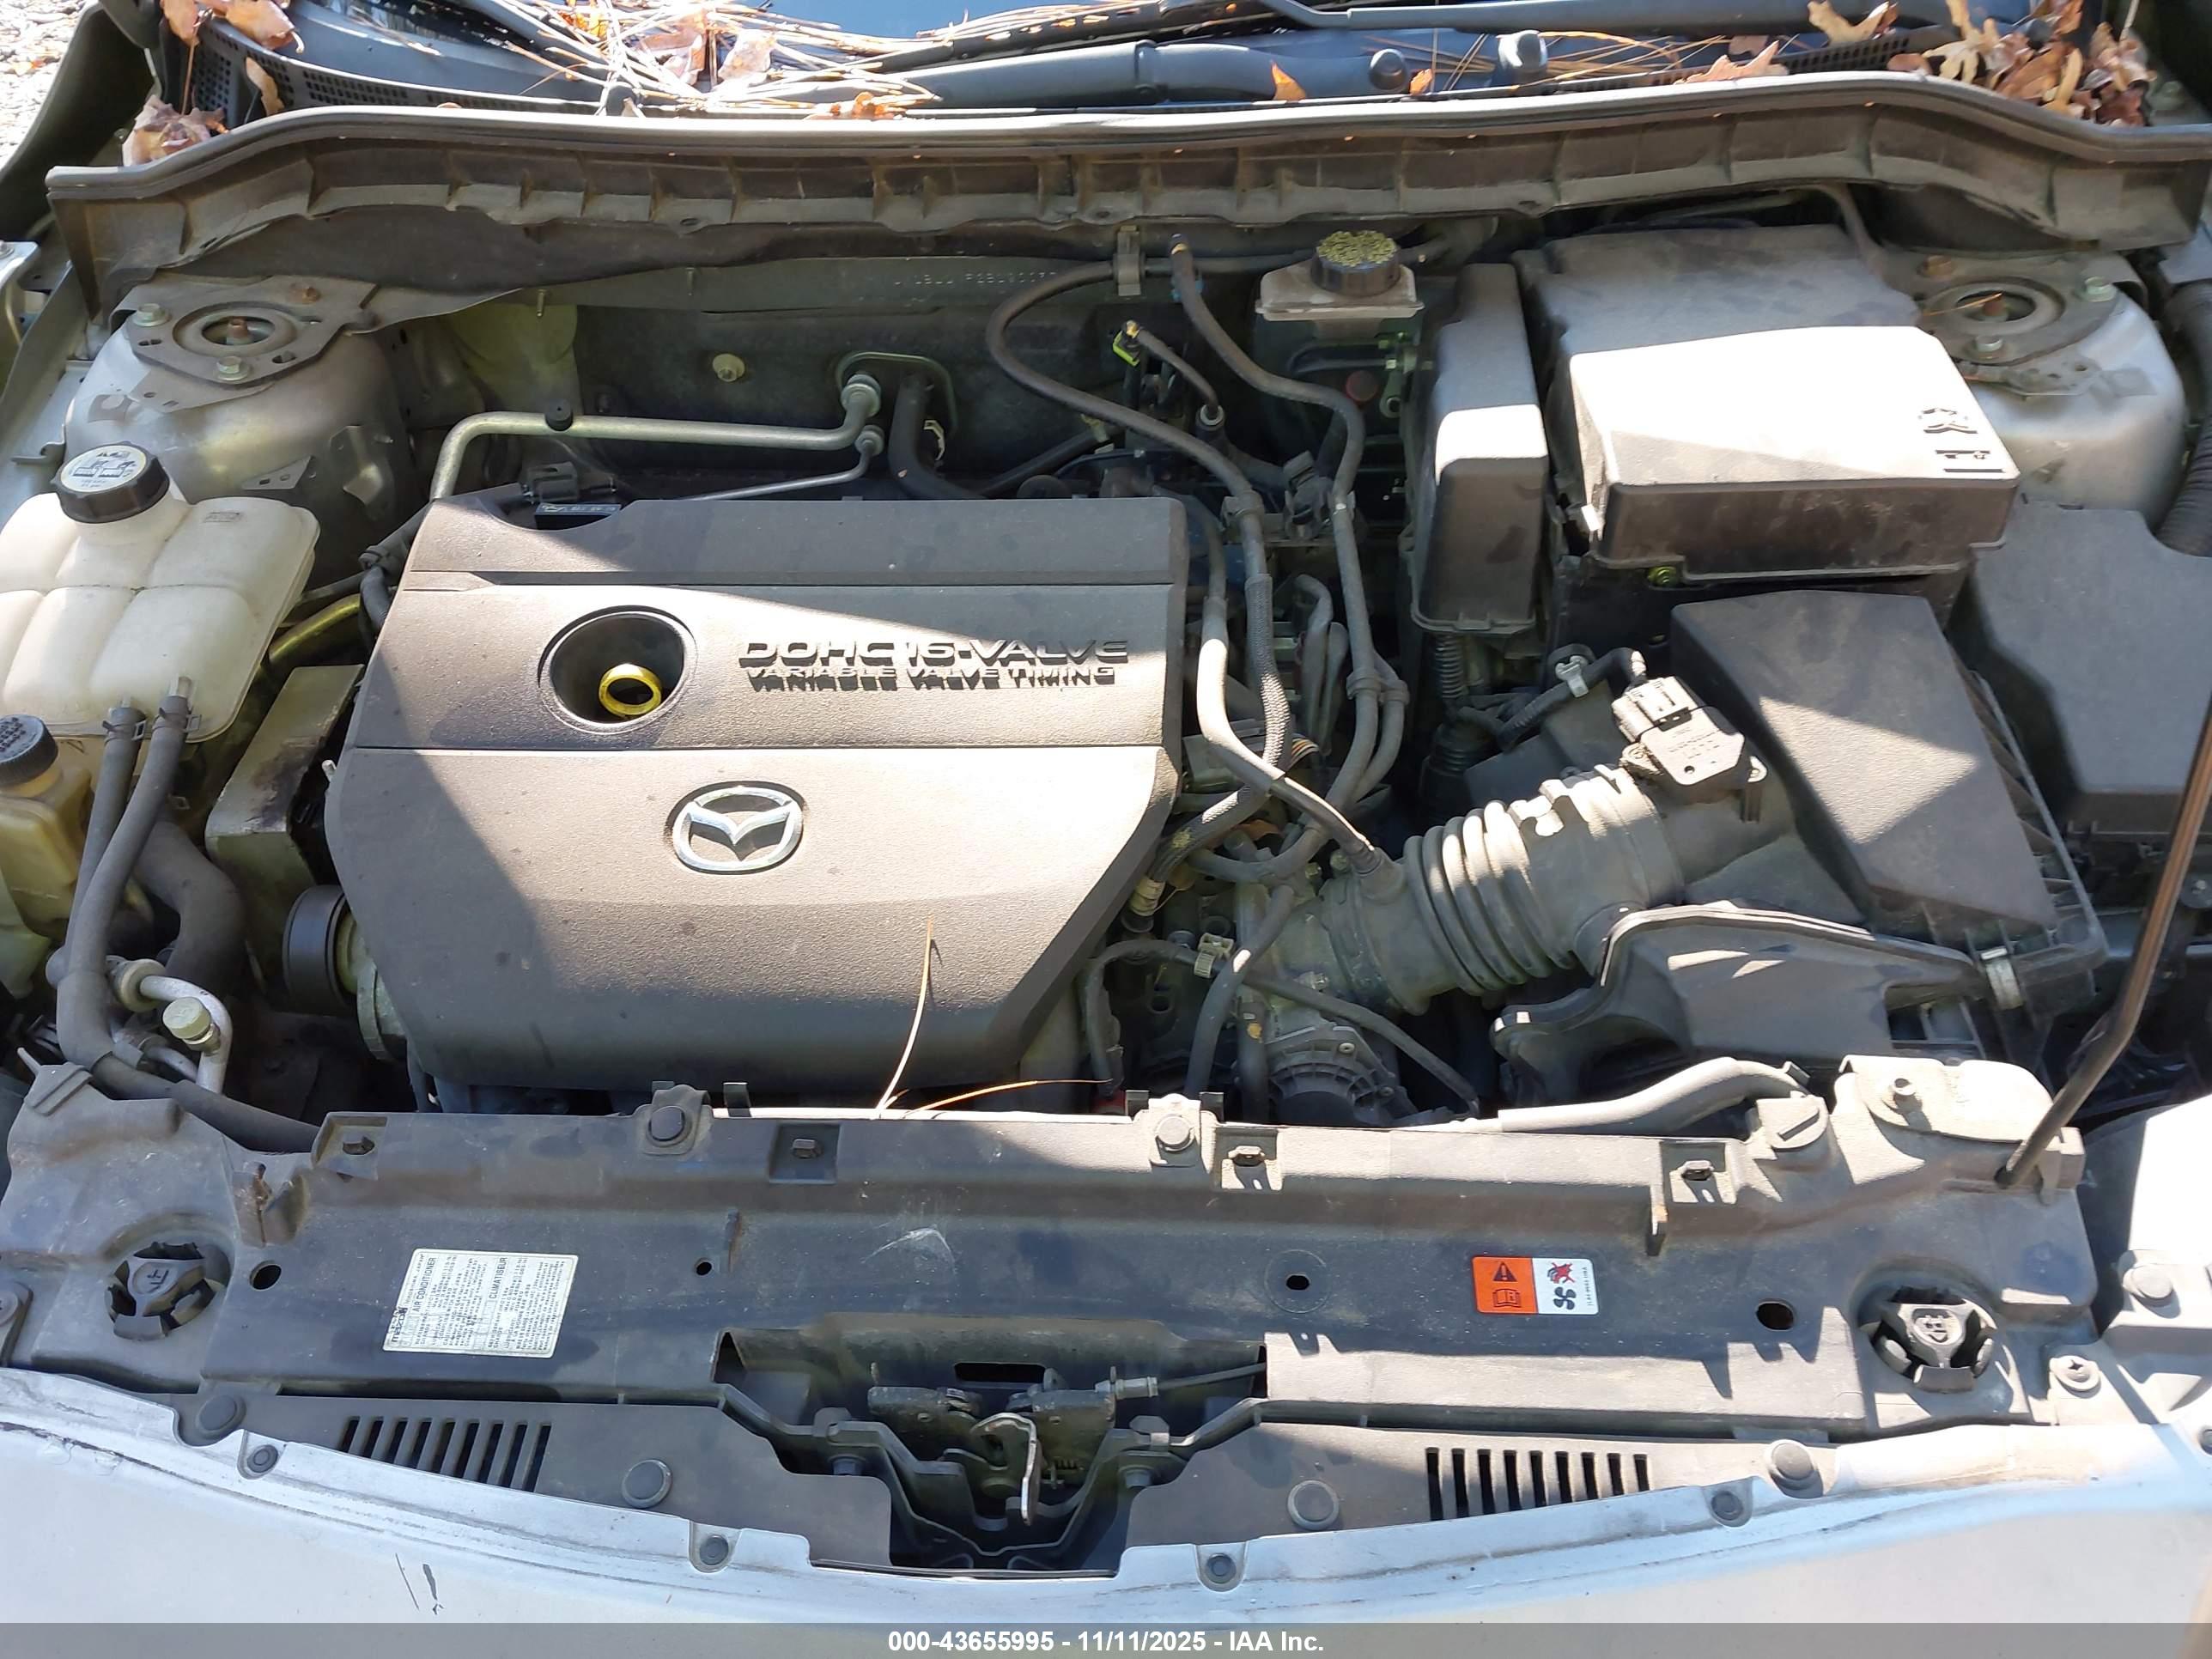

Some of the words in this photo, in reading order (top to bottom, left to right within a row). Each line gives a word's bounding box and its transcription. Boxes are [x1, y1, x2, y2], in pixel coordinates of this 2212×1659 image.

[738, 640, 895, 667] DOHC
[906, 638, 1129, 666] 16-VALVE
[745, 665, 898, 690] VARIABLE
[908, 665, 1000, 689] VALVE
[1009, 665, 1115, 686] TIMING
[416, 1257, 436, 1299] CONDITIONER
[489, 1257, 507, 1298] CLIMATISEUR
[411, 1300, 422, 1311] AIR
